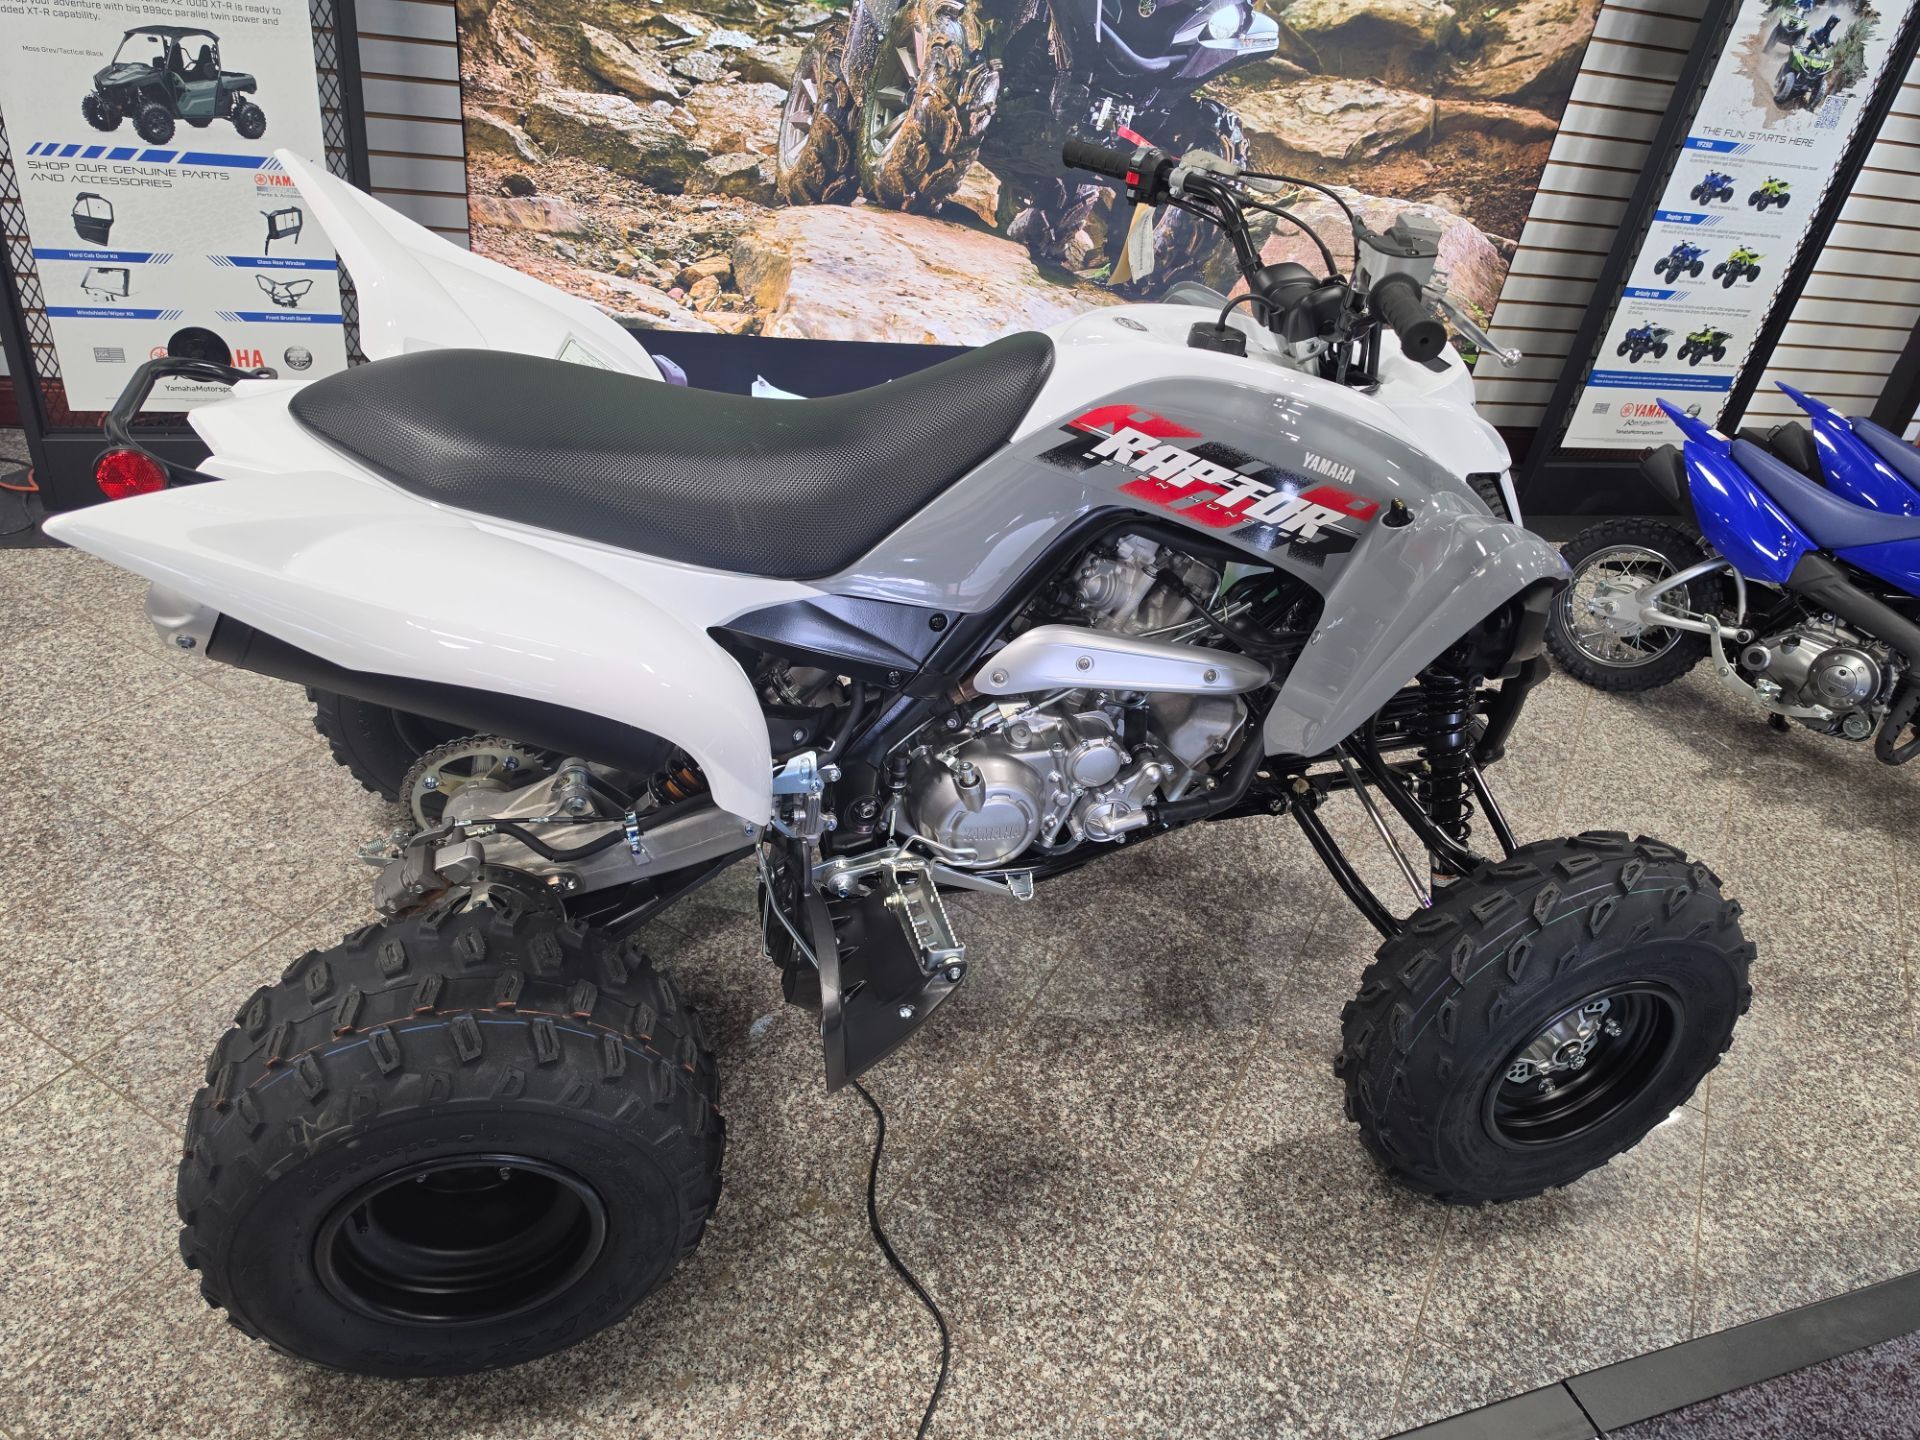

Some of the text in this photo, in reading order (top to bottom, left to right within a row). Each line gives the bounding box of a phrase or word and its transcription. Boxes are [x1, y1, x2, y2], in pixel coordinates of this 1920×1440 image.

[26, 6, 50, 16] XT-R
[53, 8, 101, 20] capability.
[54, 0, 102, 10] adventure
[104, 2, 124, 11] with
[126, 4, 140, 14] big
[142, 5, 172, 16] 999cc
[175, 8, 208, 19] parallel
[211, 12, 230, 20] twin
[232, 14, 260, 23] power
[262, 17, 280, 26] and
[211, 2, 232, 10] XT-R
[245, 5, 270, 14] ready
[272, 7, 282, 15] to
[22, 45, 40, 53] Moss
[1703, 126, 1815, 148] THE FUN STARTS HERE
[27, 160, 230, 180] SHOP OUR GENUINE PARTS
[30, 172, 173, 188] AND ACCESSORIES
[268, 175, 295, 186] YAM
[1302, 451, 1356, 485] YAMAHA
[1090, 426, 1349, 539] RAPTOR
[962, 823, 1021, 842] YAMAHA
